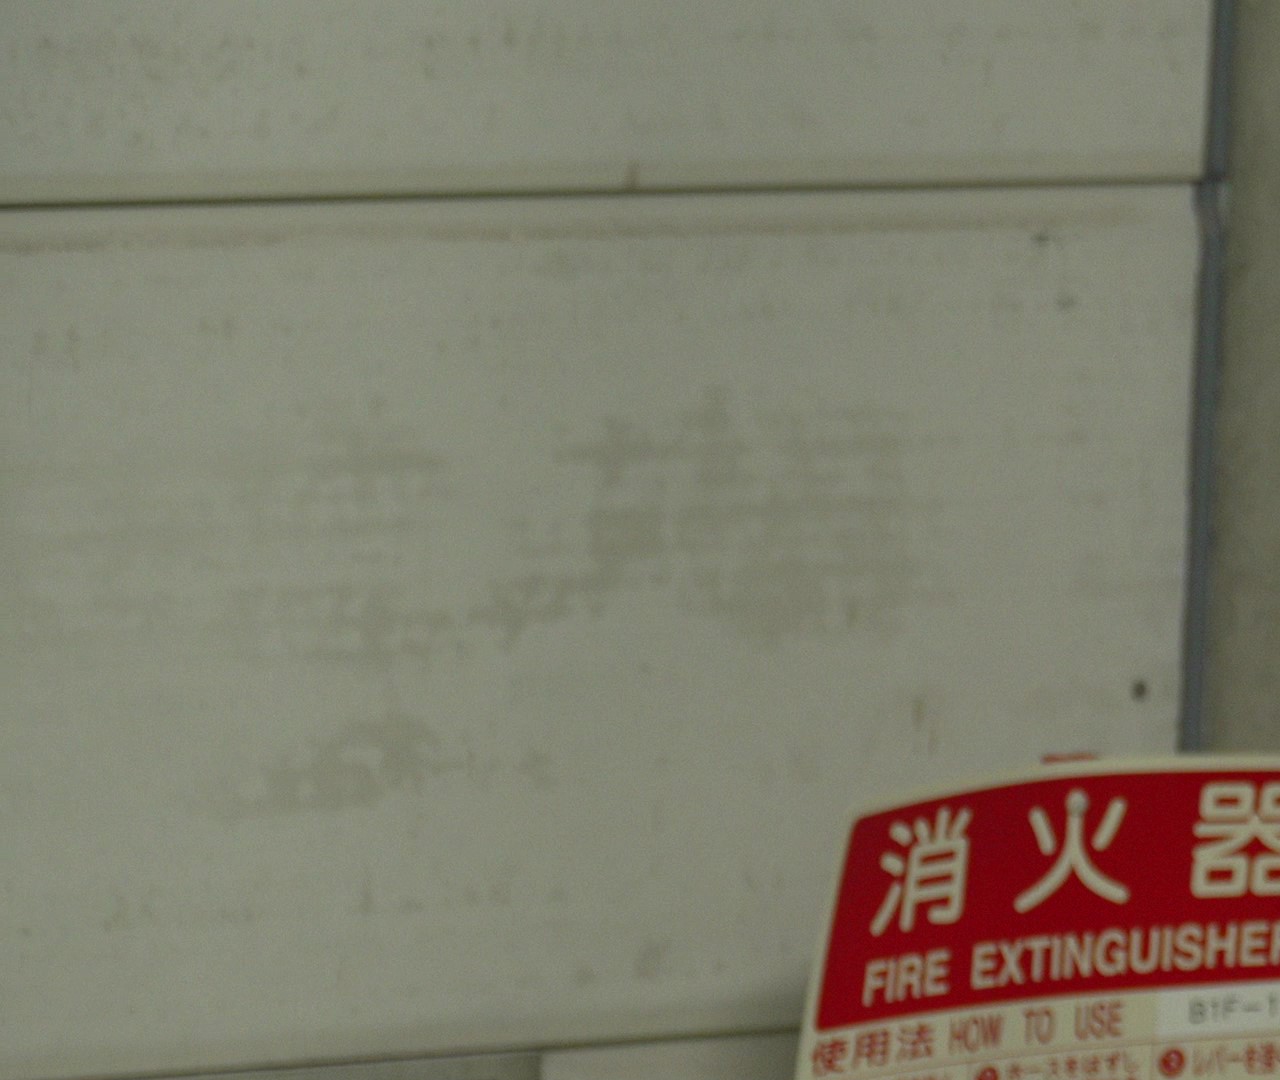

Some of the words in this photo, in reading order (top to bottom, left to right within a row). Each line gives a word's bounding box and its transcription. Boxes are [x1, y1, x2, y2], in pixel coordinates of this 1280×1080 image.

[861, 948, 951, 1007] FIRE
[812, 1023, 934, 1077] 使用法
[949, 1016, 1003, 1053] HOW
[1023, 1007, 1056, 1043] TO
[1074, 1001, 1124, 1041] USE
